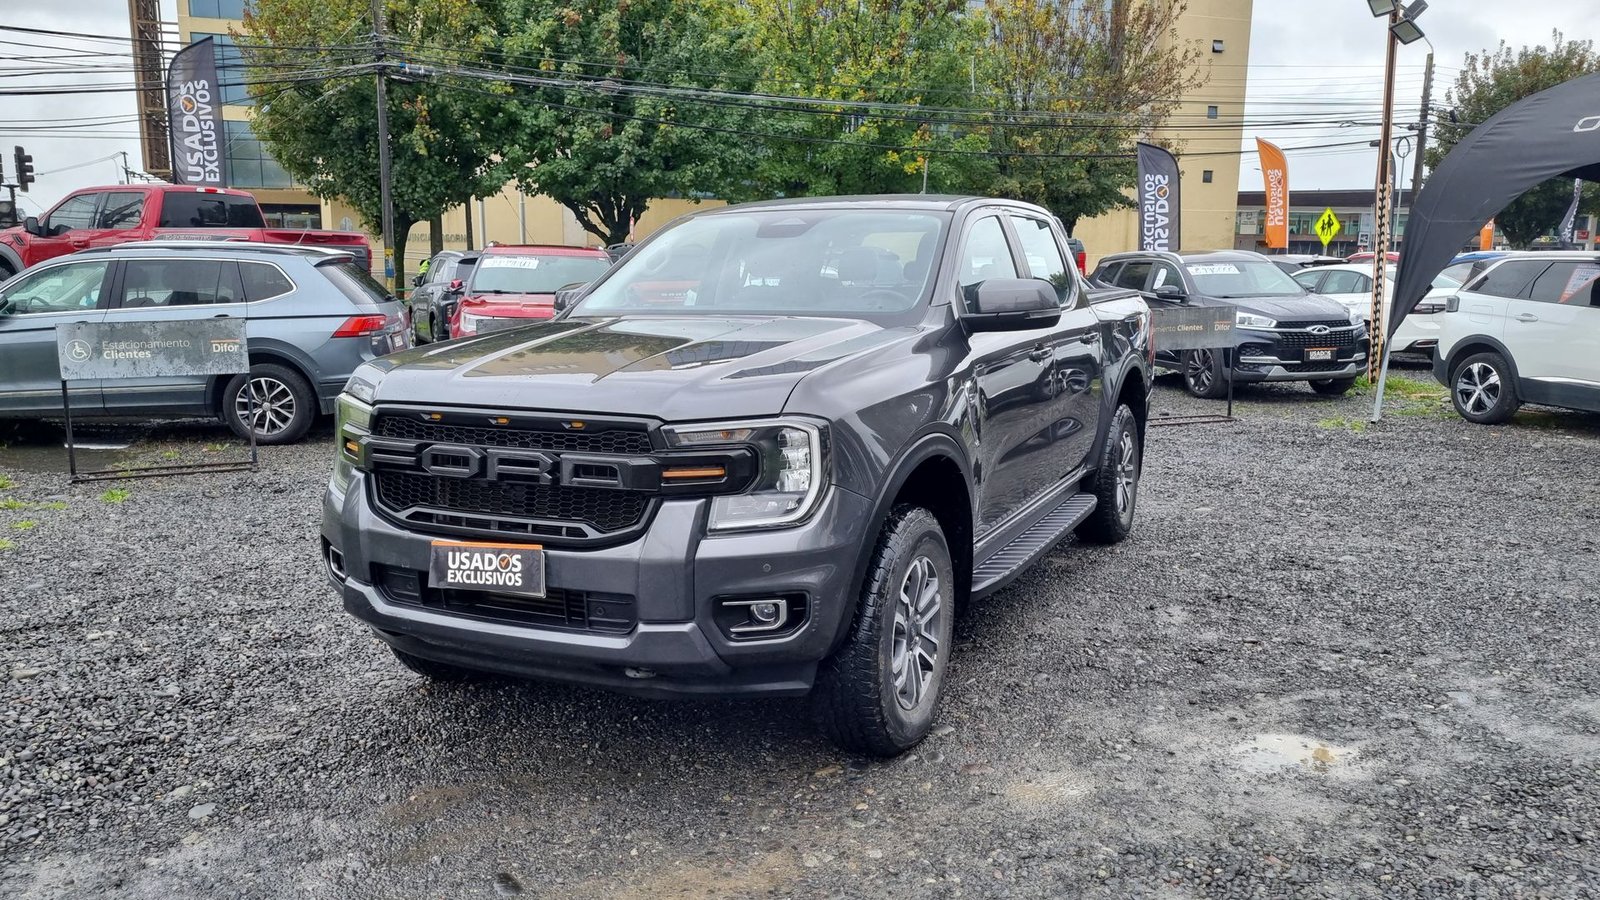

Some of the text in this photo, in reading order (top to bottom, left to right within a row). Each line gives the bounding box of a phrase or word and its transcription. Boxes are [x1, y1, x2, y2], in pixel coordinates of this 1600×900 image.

[180, 81, 204, 182] USADOS
[194, 79, 220, 182] EXCLUSIVOS
[1177, 324, 1203, 332] Clientes
[1214, 323, 1231, 331] Difor
[102, 339, 190, 350] Estacionamiento
[212, 343, 240, 353] Difor
[103, 350, 151, 360] Clientes
[363, 435, 645, 490] FORD
[447, 551, 522, 573] USADOS
[447, 569, 523, 587] EXCLUSIVOS
